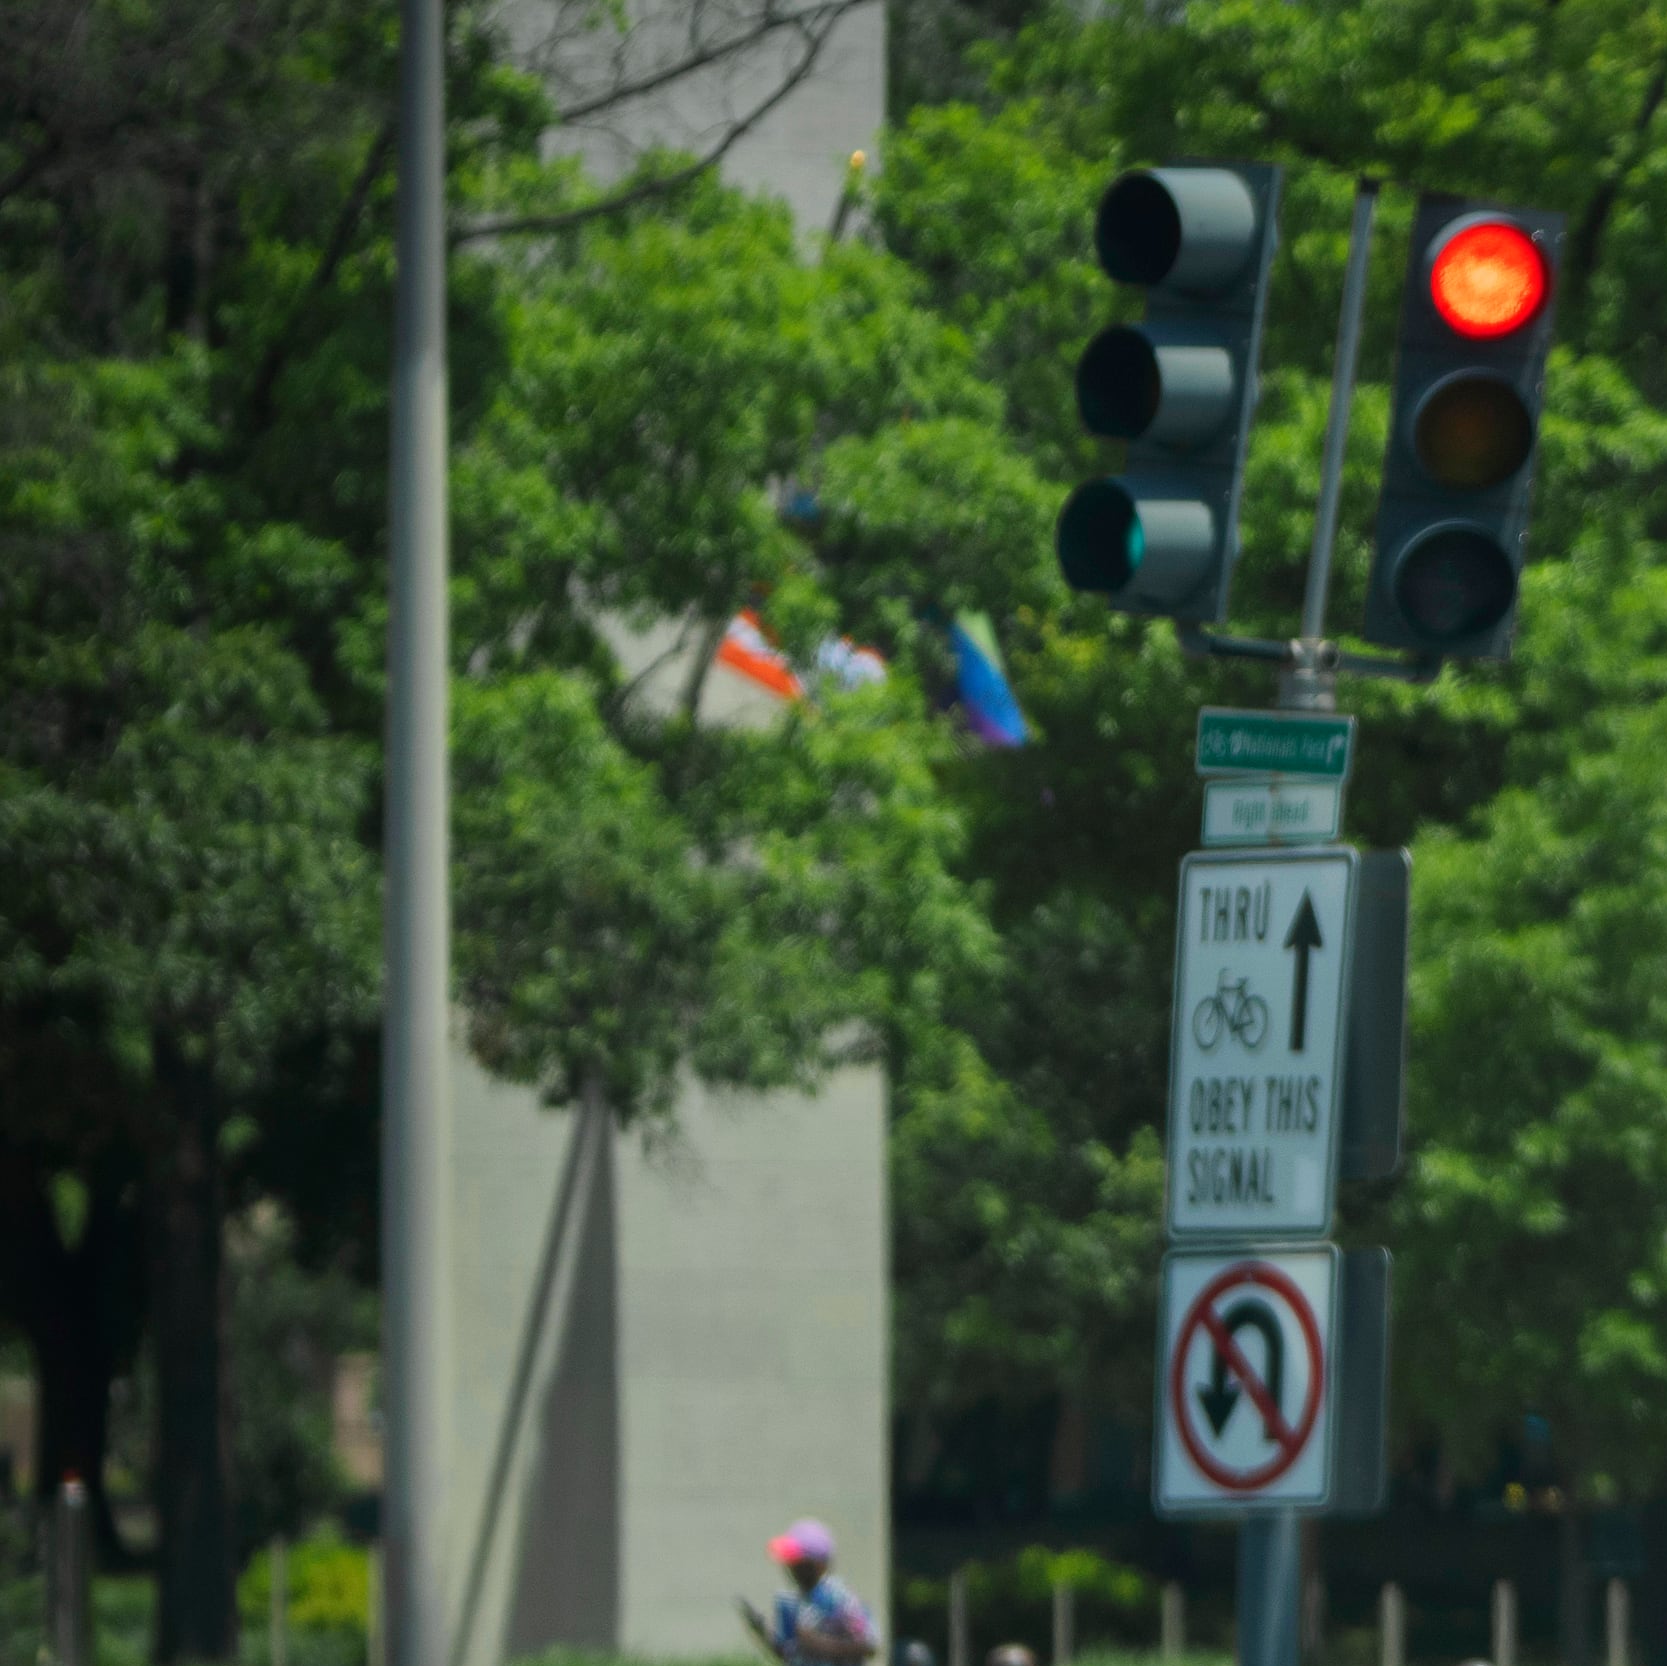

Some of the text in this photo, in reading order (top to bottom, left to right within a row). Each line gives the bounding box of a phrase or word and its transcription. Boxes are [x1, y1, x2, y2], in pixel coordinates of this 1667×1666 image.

[1200, 880, 1271, 943] THRU
[1189, 1075, 1320, 1135] OBEY THIS
[1187, 1146, 1275, 1207] SIGNAL
